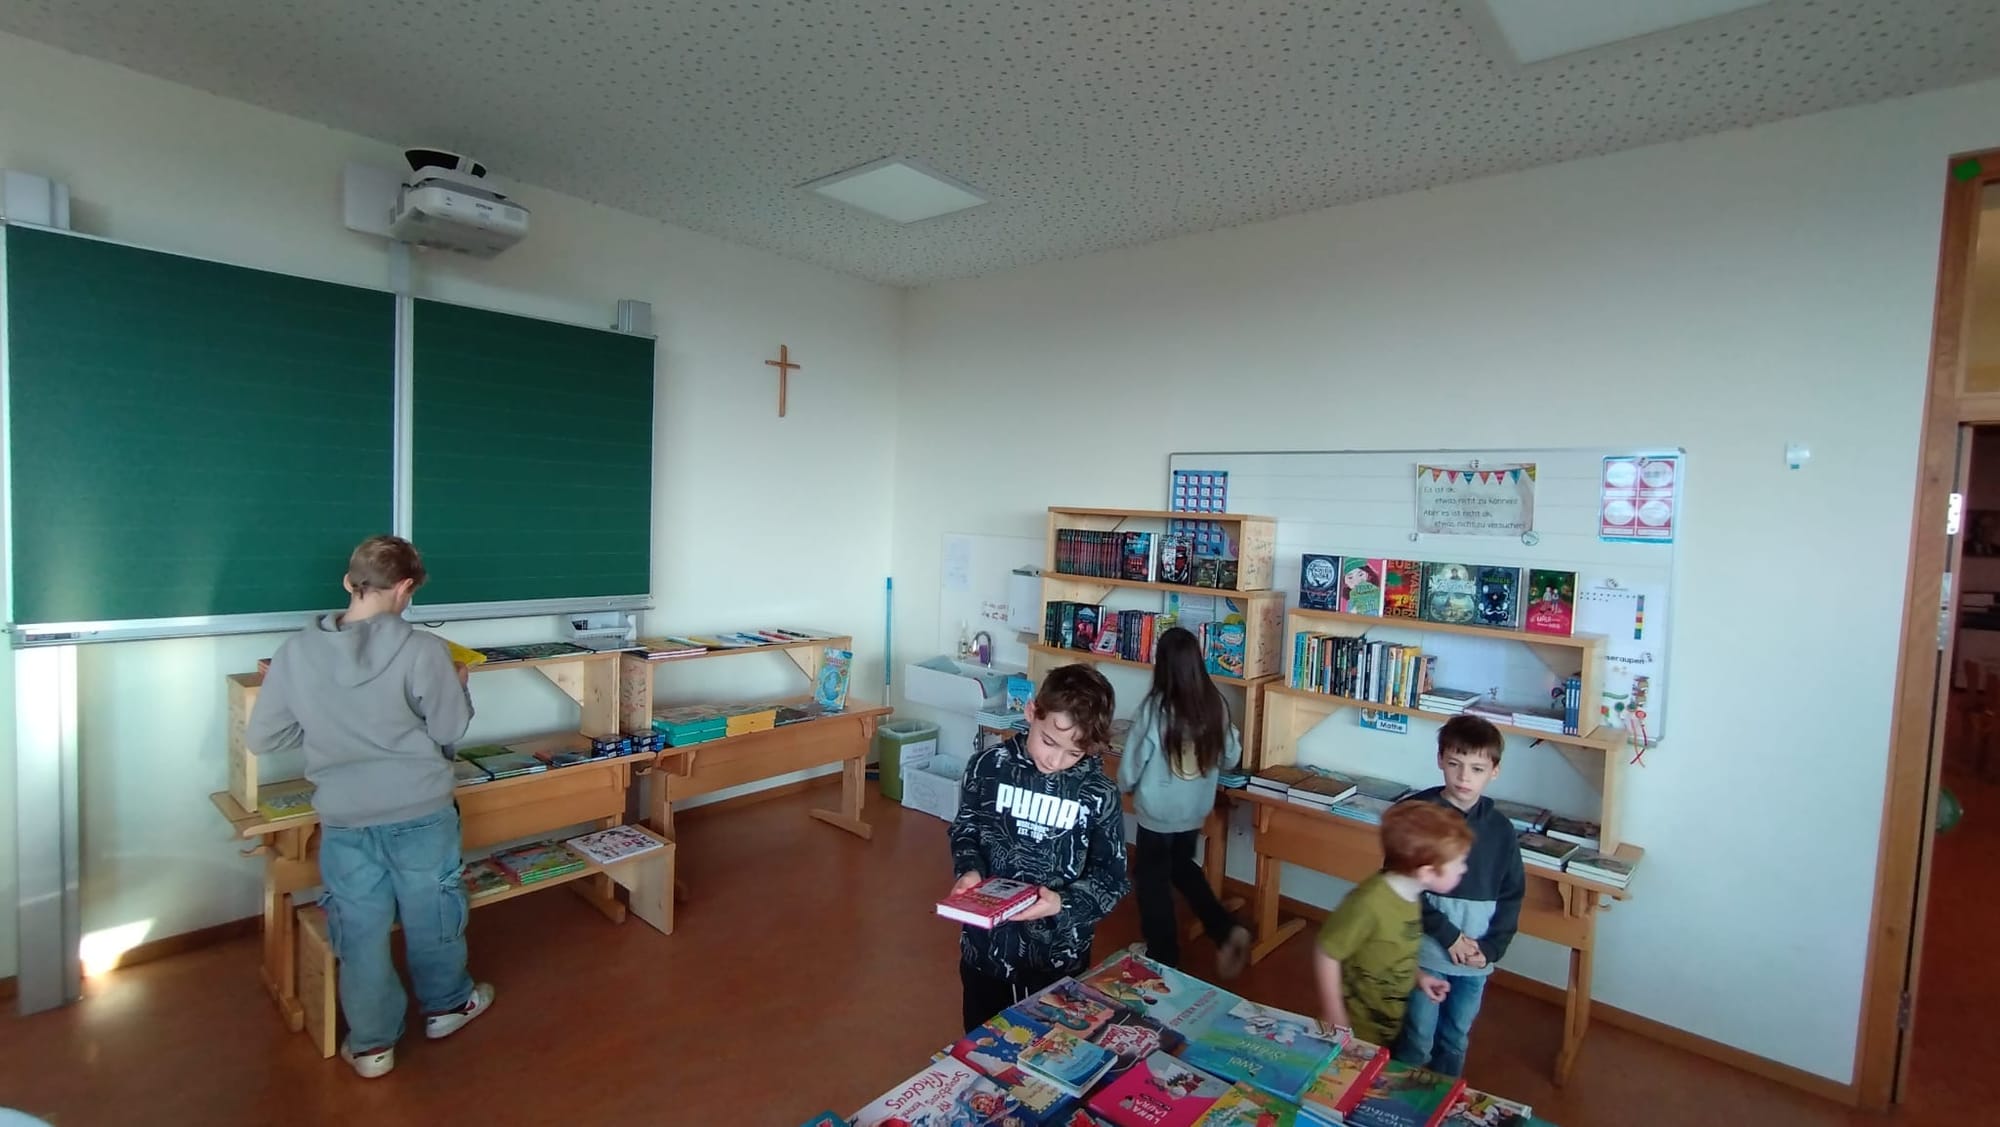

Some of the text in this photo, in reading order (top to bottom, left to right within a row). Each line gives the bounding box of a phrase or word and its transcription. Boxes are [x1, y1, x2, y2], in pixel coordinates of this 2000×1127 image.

[1380, 721, 1403, 731] Mathe
[995, 783, 1081, 830] PUMA
[885, 1070, 949, 1110] Nikolaus
